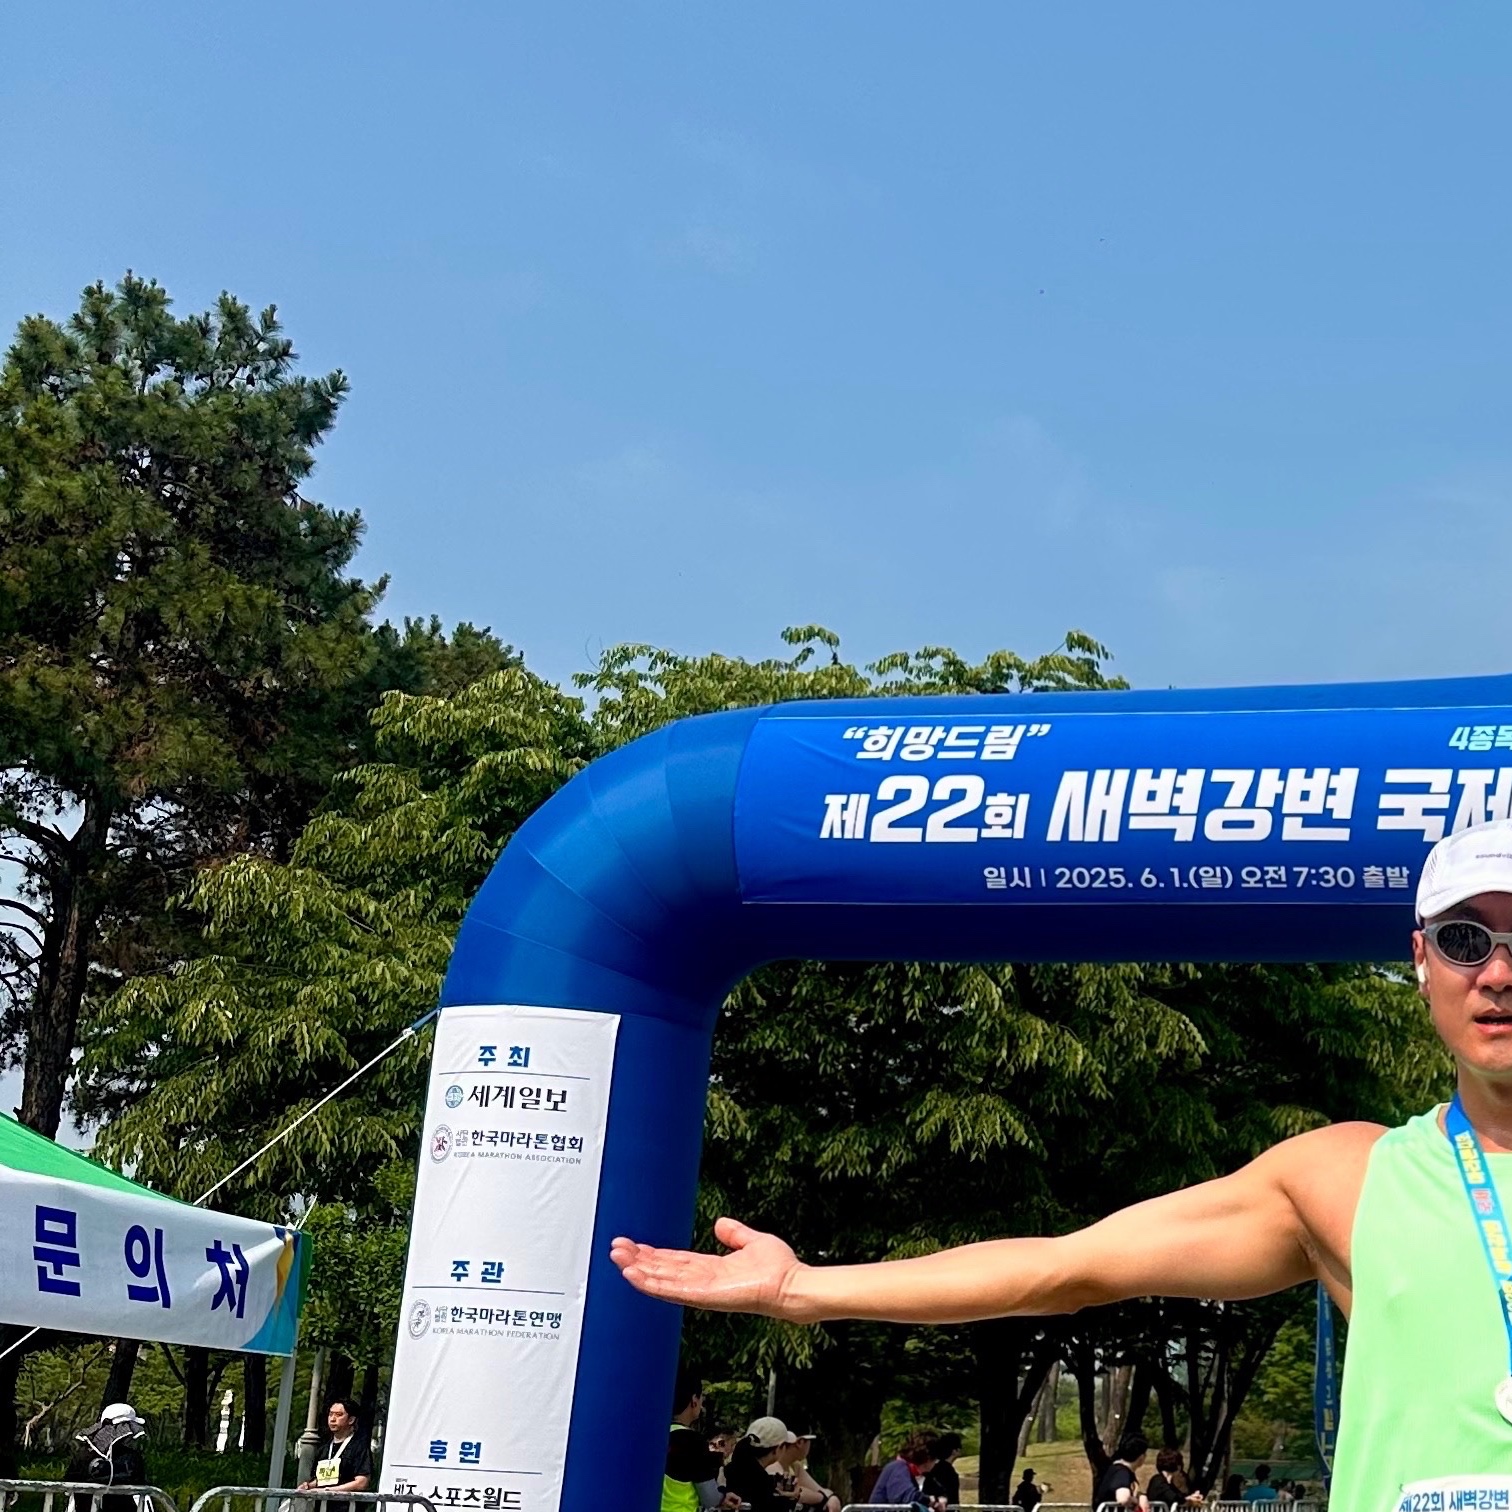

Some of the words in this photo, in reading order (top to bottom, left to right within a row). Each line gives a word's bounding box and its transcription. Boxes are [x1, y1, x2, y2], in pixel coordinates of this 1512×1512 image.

[819, 774, 1030, 843] 제22회
[1046, 767, 1360, 843] 새벽강변
[983, 866, 1032, 889] 일시
[1054, 867, 1134, 888] 2025.
[1240, 865, 1288, 888] 오전
[1292, 866, 1355, 888] 7:30
[1362, 865, 1410, 889] 출발
[467, 1085, 568, 1112] 세계일보
[470, 1129, 584, 1153] 한국마라톤협회
[477, 1151, 523, 1160] MARATHON
[449, 1306, 563, 1329] 한국마라톤연맹
[456, 1328, 504, 1337] MARATHON
[428, 1485, 522, 1511] 스포츠월드
[1449, 1489, 1510, 1512] 새벽강변
